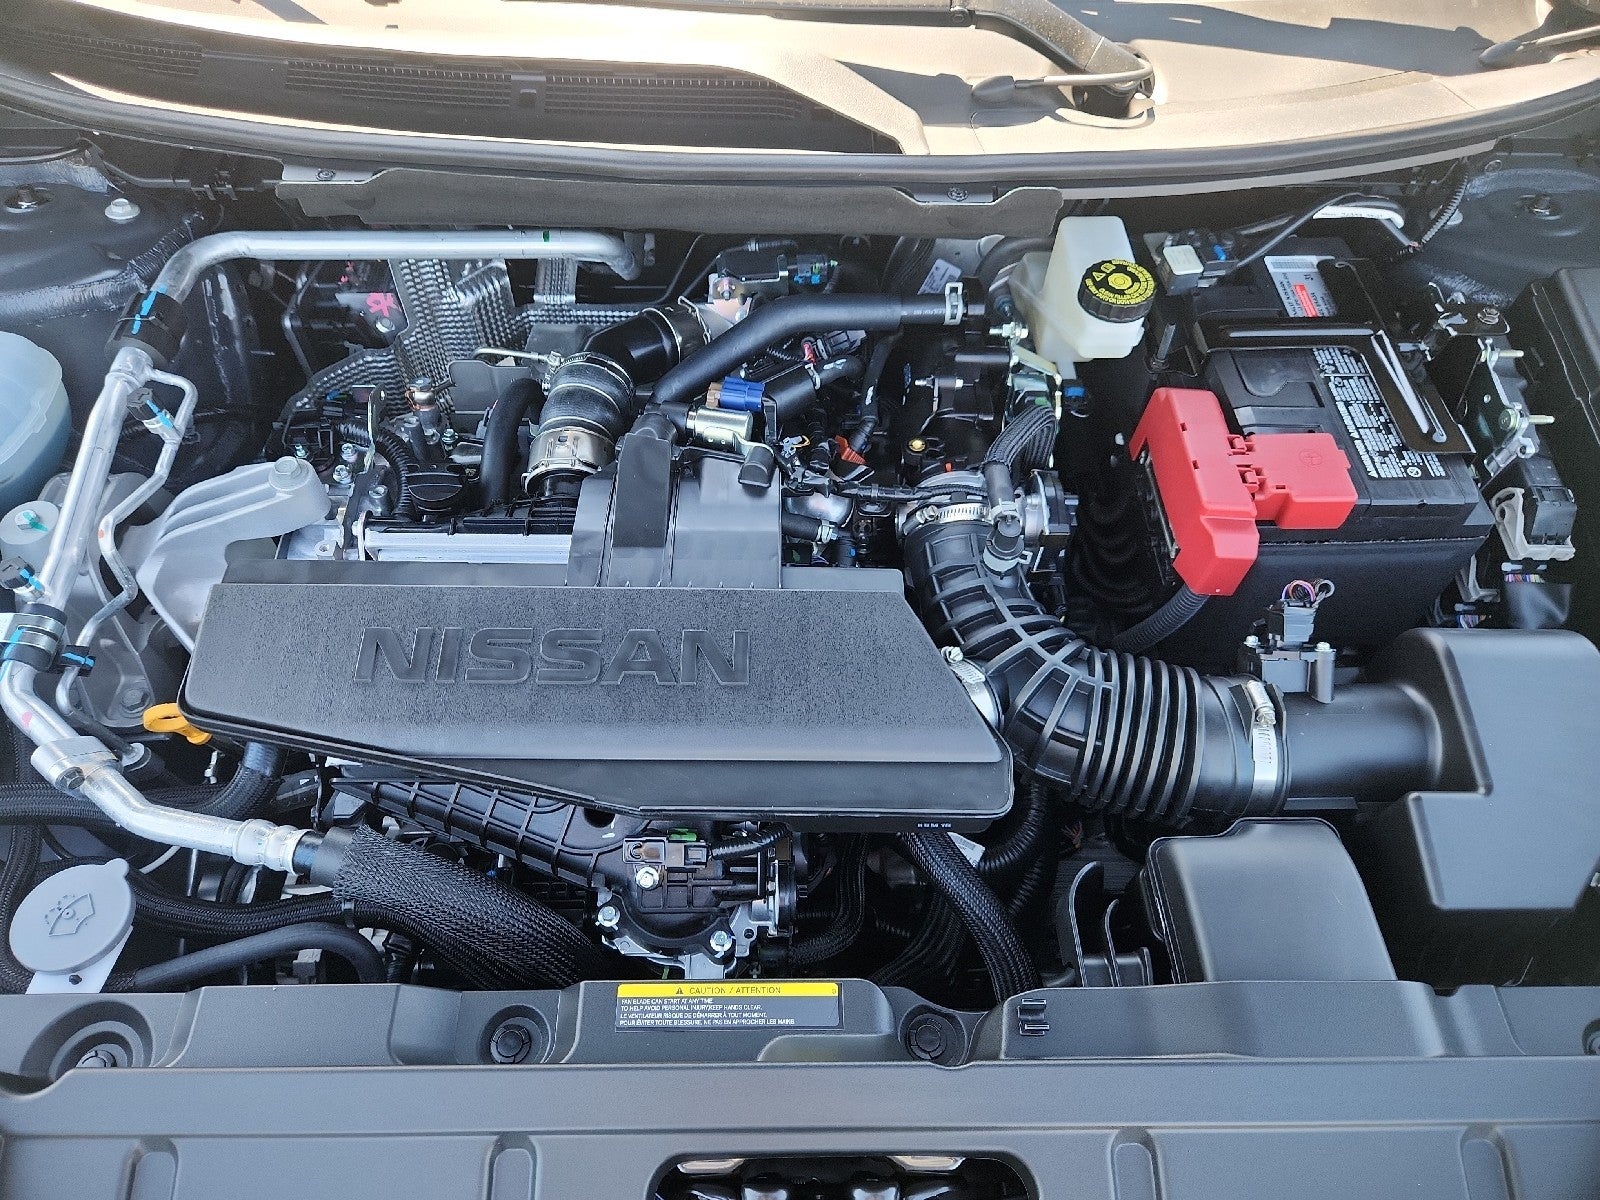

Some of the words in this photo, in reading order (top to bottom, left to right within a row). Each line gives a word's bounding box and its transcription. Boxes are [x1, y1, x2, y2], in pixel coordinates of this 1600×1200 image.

[354, 626, 750, 686] NISSAN
[689, 986, 726, 995] CAUTION
[735, 986, 781, 994] ATTENTION
